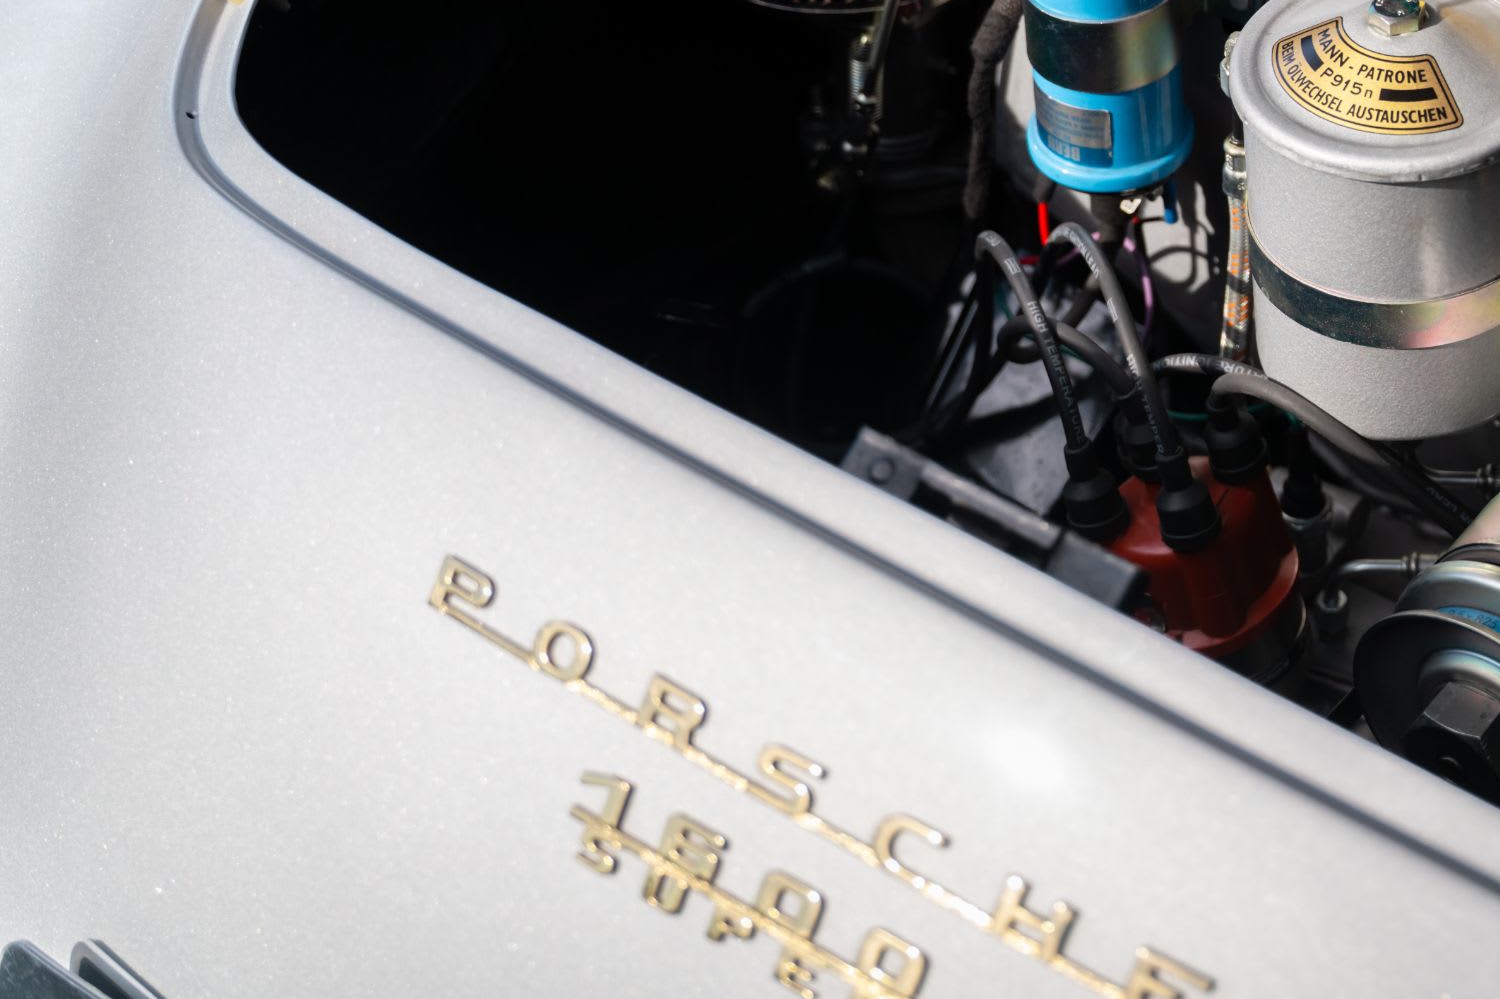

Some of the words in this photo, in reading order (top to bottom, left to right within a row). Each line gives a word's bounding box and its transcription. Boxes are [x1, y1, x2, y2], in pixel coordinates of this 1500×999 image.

[1281, 41, 1295, 66] BEIM
[1346, 105, 1448, 124] AUSTAUSCHEN
[1318, 28, 1350, 67] MANN
[1357, 64, 1428, 83] PATRONE
[1027, 300, 1048, 333] HIGH
[427, 554, 1217, 999] PORSCHE
[570, 770, 929, 999] 1600
